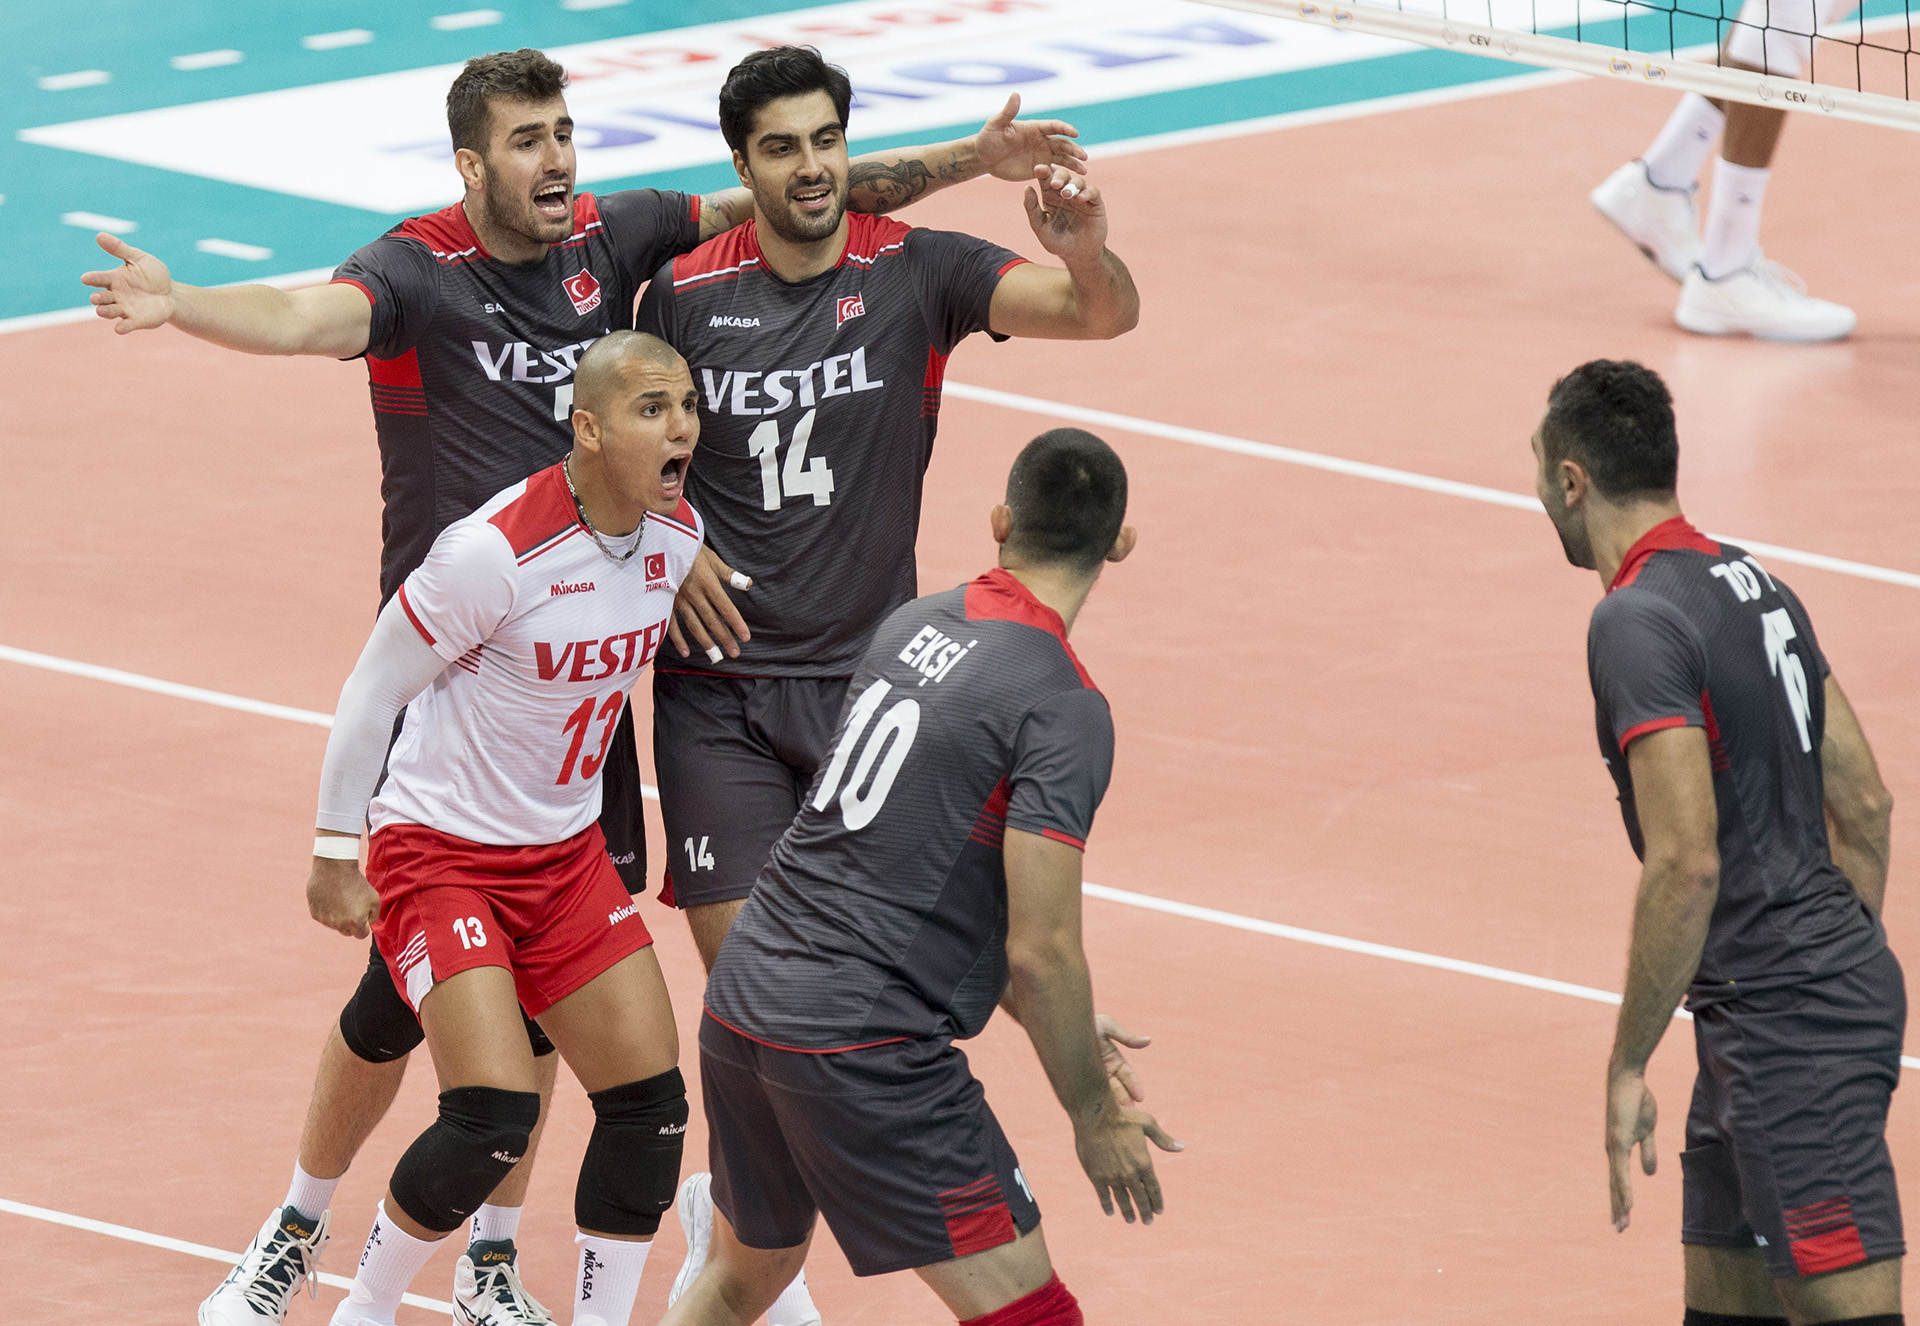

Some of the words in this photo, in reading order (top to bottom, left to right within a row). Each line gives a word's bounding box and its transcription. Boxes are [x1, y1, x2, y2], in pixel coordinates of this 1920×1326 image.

[1469, 34, 1490, 47] CEV
[1785, 90, 1807, 103] CEV
[471, 336, 602, 384] VEST
[701, 346, 884, 415] VESTEL
[748, 408, 835, 511] 14
[550, 581, 596, 597] MIKASA
[555, 690, 624, 786] 13
[811, 678, 921, 831] 10
[684, 836, 715, 872] 14
[453, 916, 488, 950] 13
[608, 904, 639, 926] MIKAS
[1014, 1165, 1034, 1203] 1
[582, 1248, 600, 1301] MIKASA
